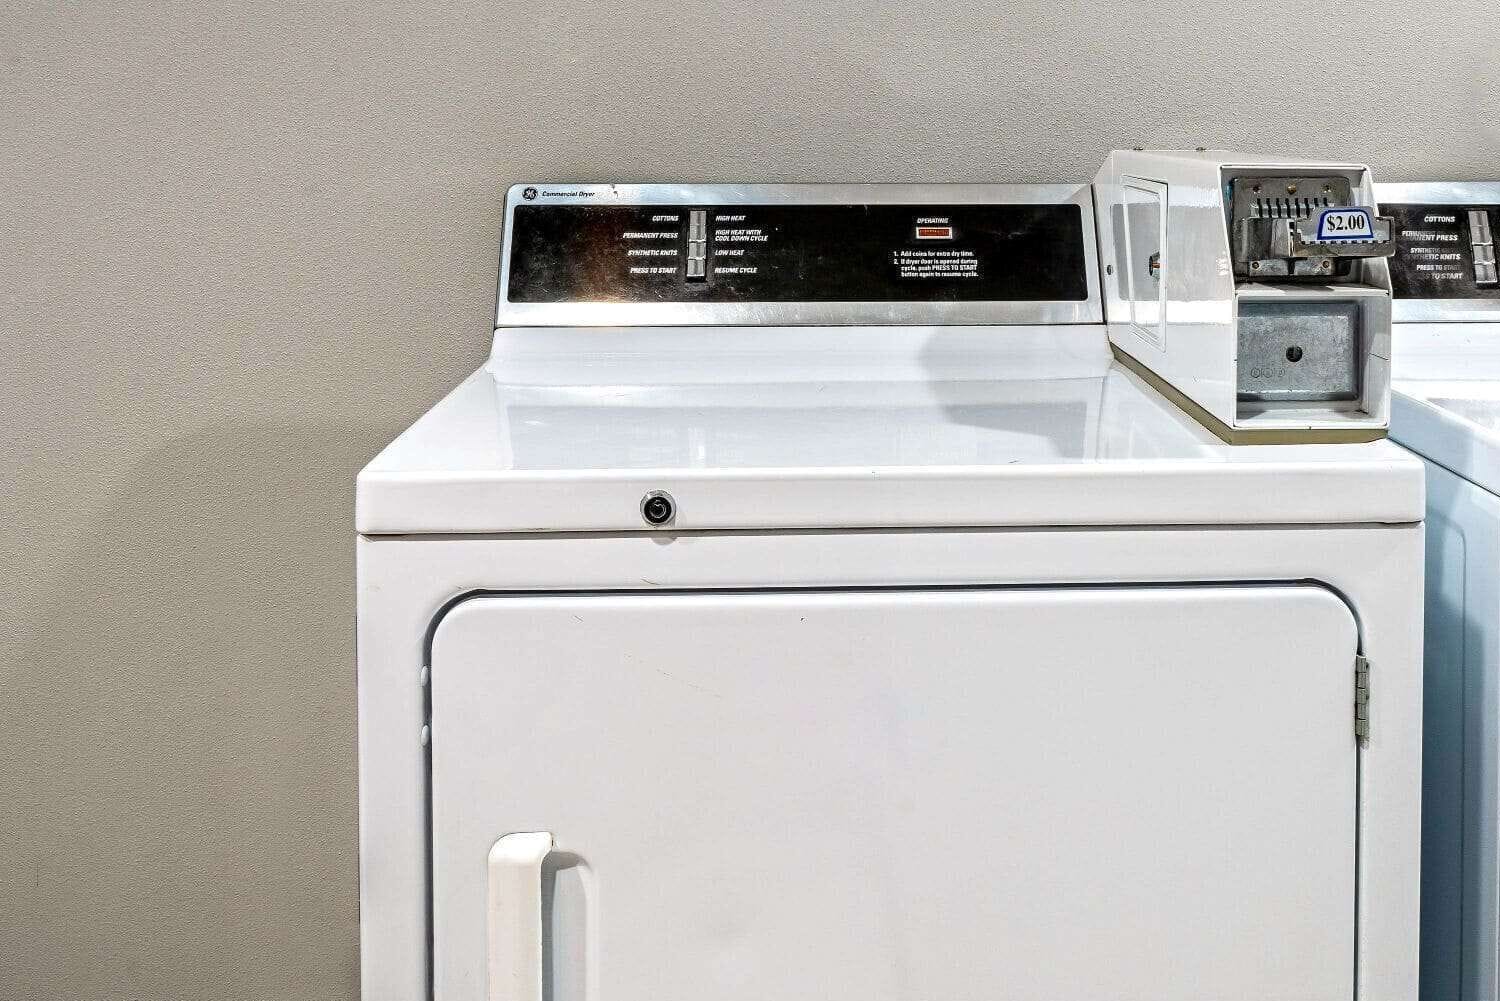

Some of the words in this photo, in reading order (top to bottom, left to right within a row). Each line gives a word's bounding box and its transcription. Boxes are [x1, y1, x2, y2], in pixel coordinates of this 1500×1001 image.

[1424, 215, 1456, 223] COTTONS
[1326, 214, 1365, 233] $2.00
[951, 250, 960, 258] dry
[905, 258, 920, 266] dryer
[960, 258, 978, 266] during
